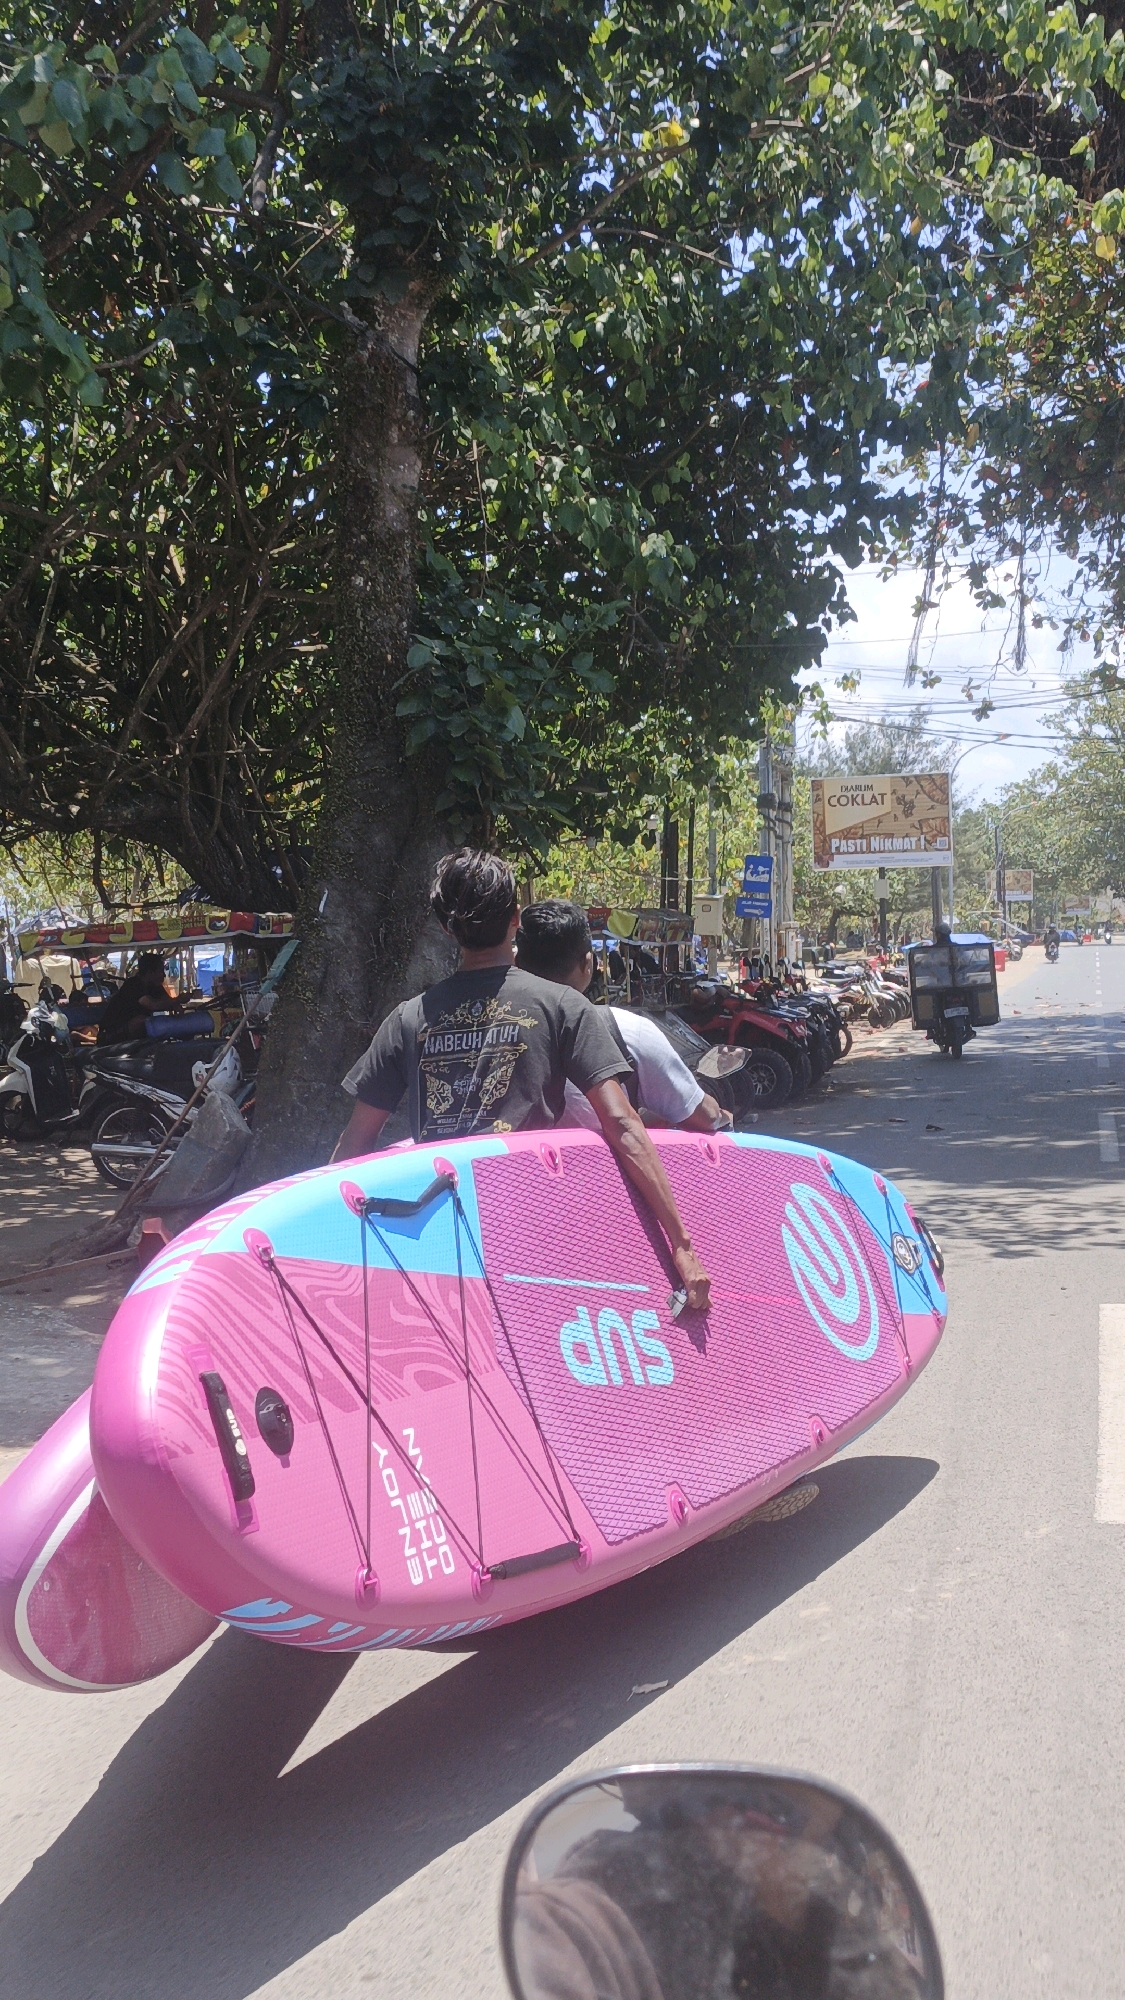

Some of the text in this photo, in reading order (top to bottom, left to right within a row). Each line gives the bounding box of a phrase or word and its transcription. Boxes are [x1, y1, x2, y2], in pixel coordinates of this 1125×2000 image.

[828, 793, 887, 808] COKLAT
[840, 784, 874, 793] DJARUM
[831, 838, 867, 853] PASTI
[559, 1305, 674, 1386] SUP
[371, 1441, 424, 1586] ENJOY
[402, 1427, 456, 1575] OCEAN
[406, 1491, 438, 1580] THE
